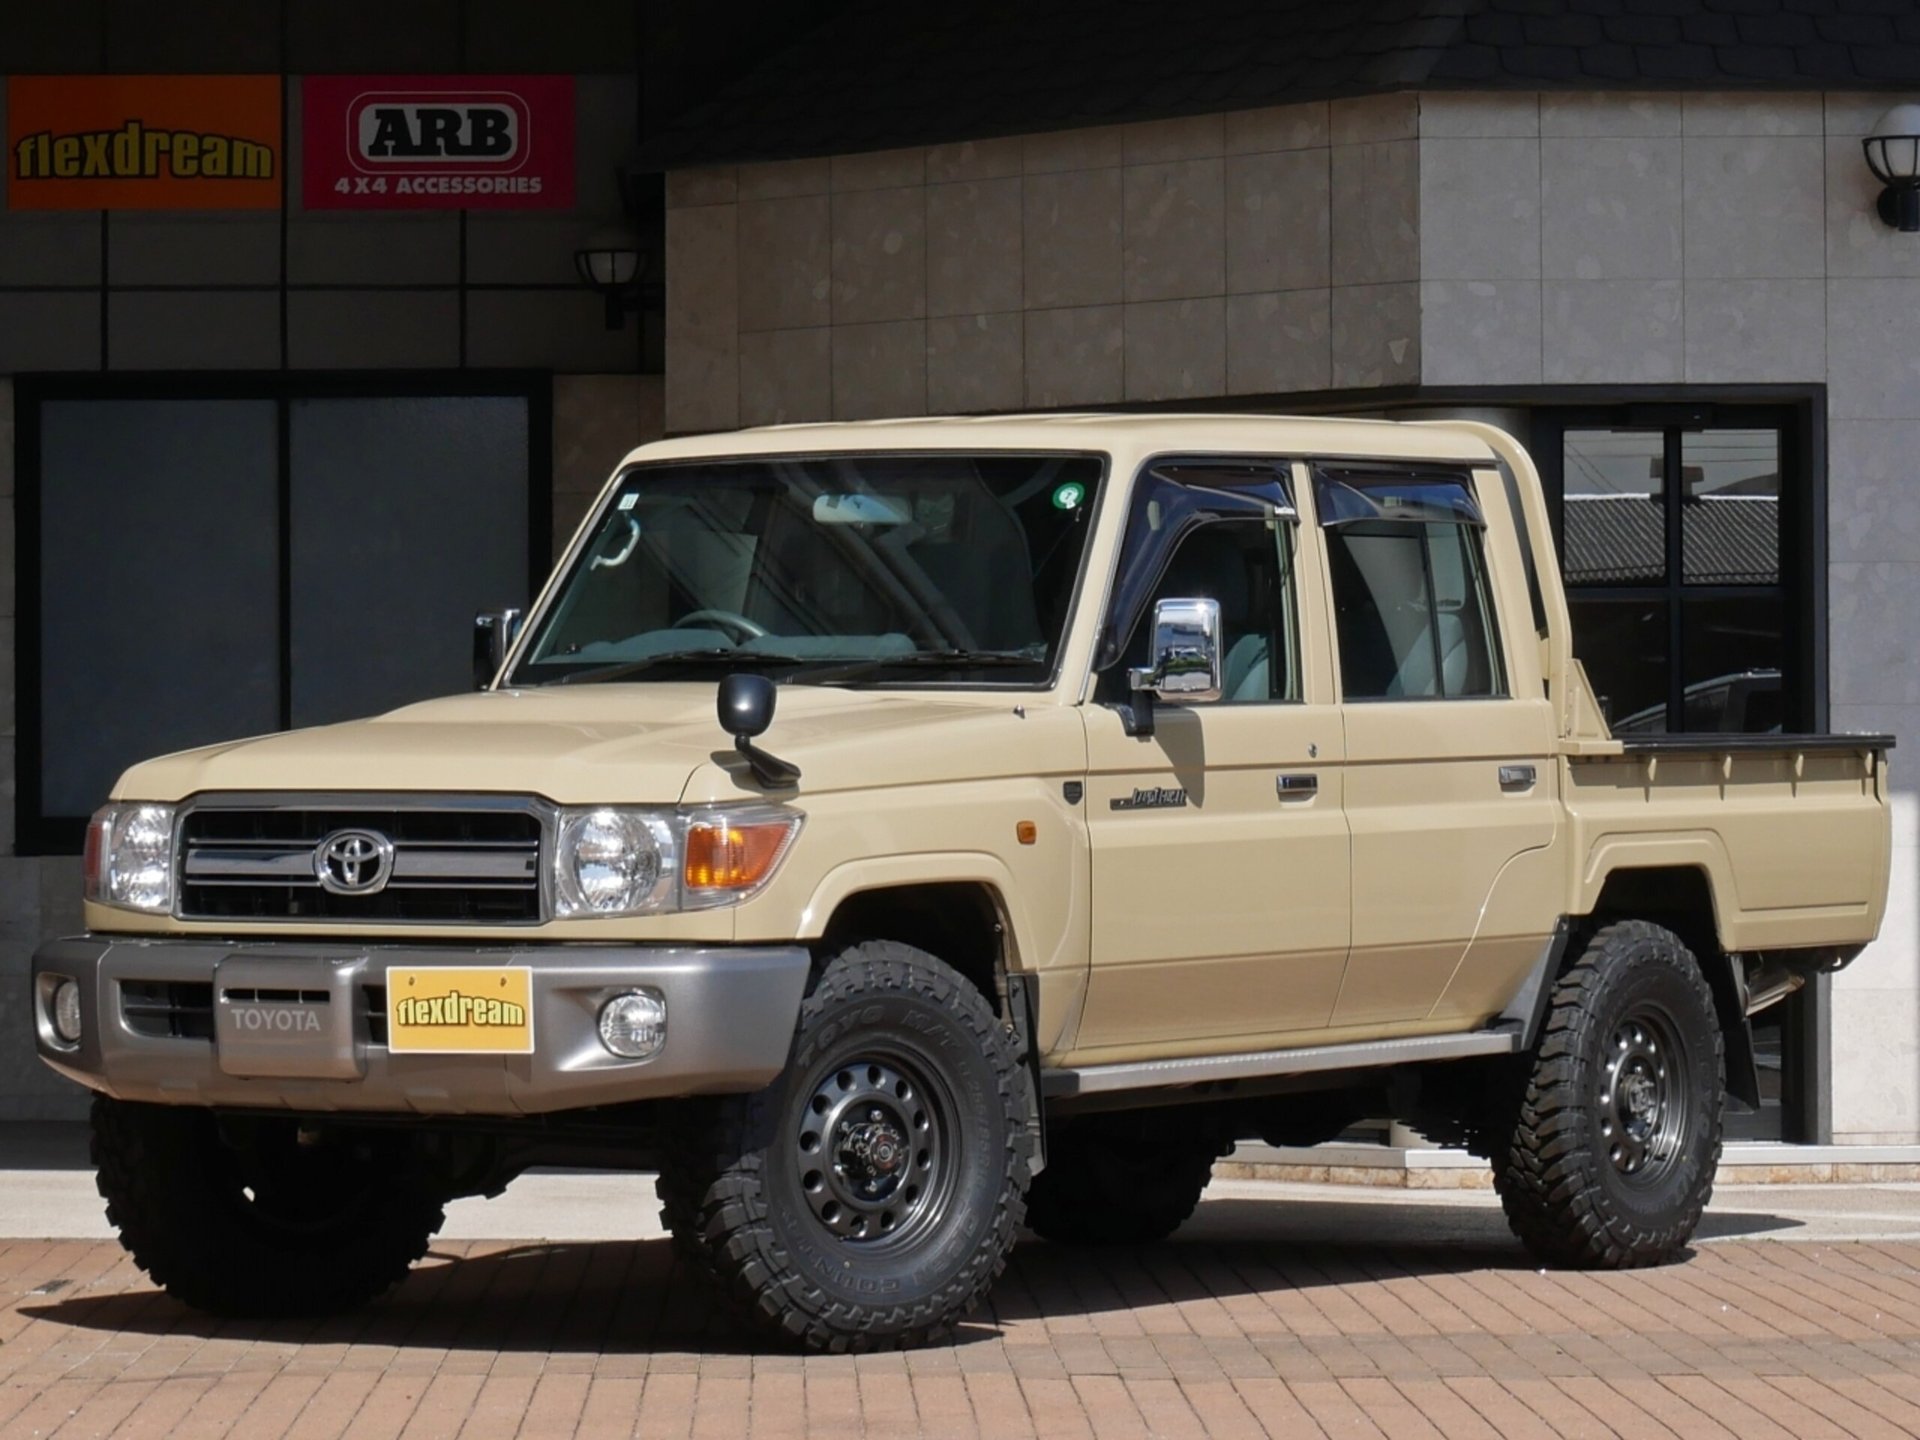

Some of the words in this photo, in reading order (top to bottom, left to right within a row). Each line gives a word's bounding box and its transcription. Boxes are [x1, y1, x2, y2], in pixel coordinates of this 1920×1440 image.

[16, 119, 274, 179] flexdream
[368, 108, 513, 157] ARB
[396, 176, 542, 194] ACCESSORIES
[231, 1008, 321, 1032] TOYOTA
[397, 989, 526, 1028] flexdream
[797, 1004, 884, 1067] TOYO
